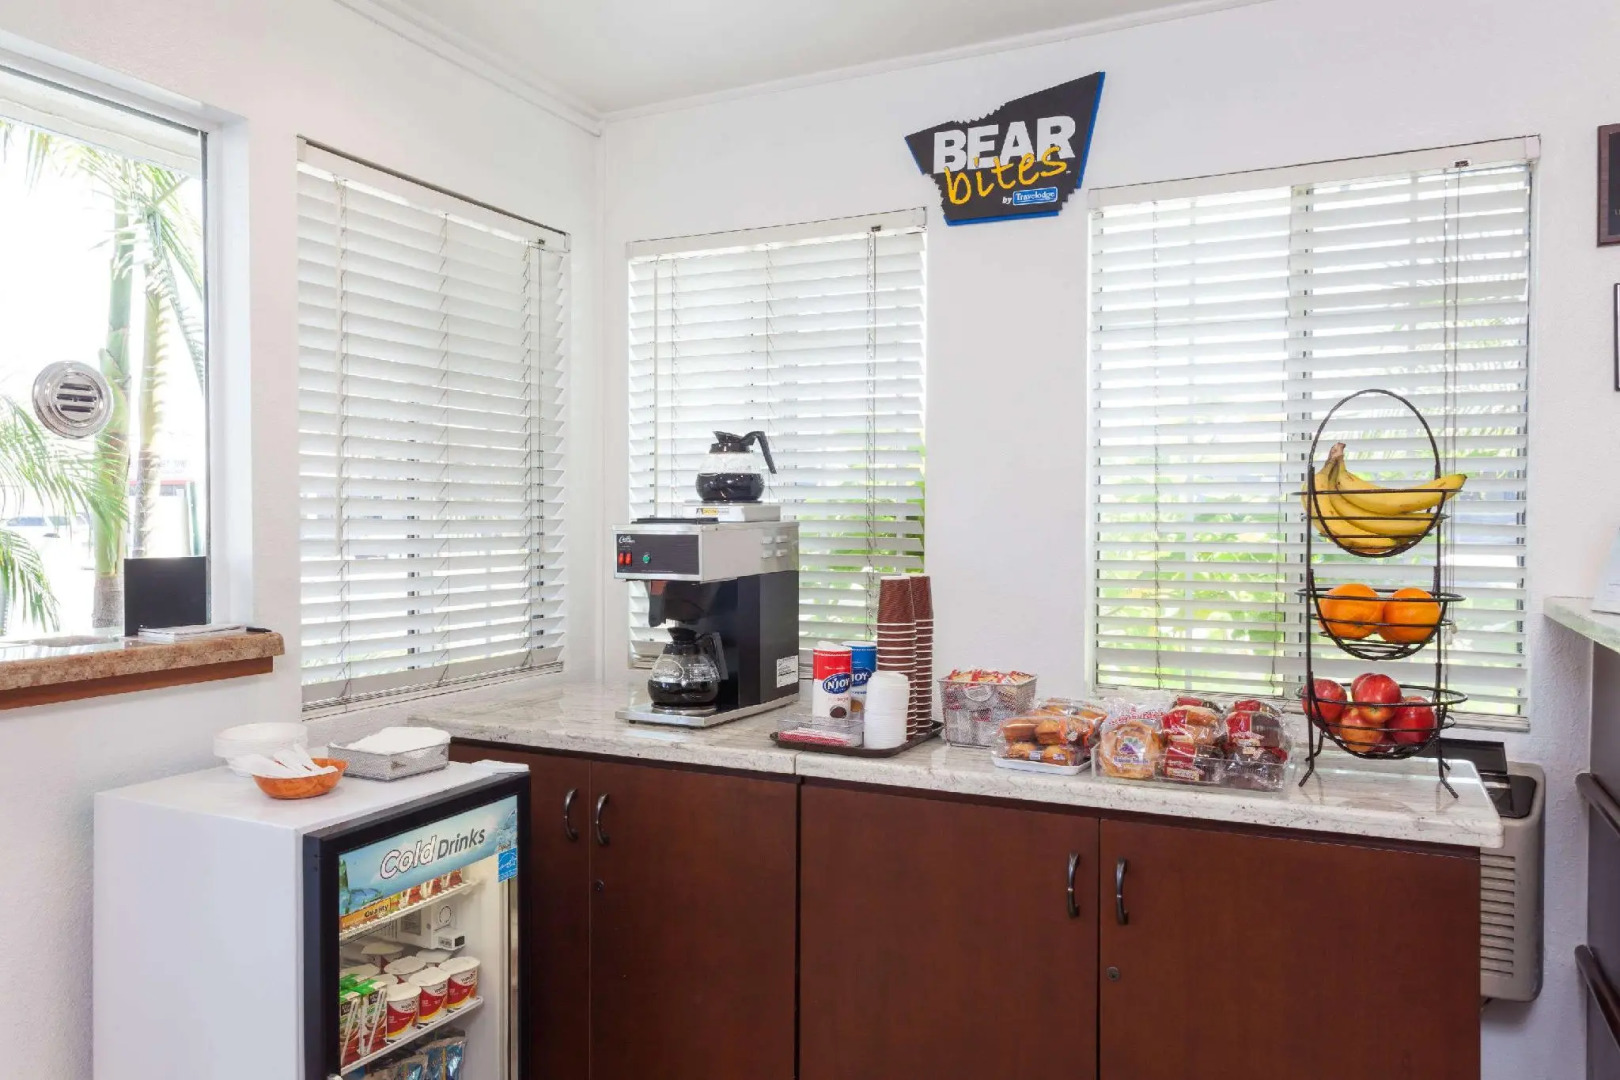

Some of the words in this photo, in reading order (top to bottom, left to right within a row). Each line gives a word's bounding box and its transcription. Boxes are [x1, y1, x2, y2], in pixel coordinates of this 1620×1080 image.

[933, 115, 1076, 175] BEAR
[944, 145, 1067, 205] bites
[1002, 196, 1012, 205] by
[1015, 190, 1056, 201] Travelodge
[380, 834, 437, 880] Cold
[437, 828, 485, 860] Drinks
